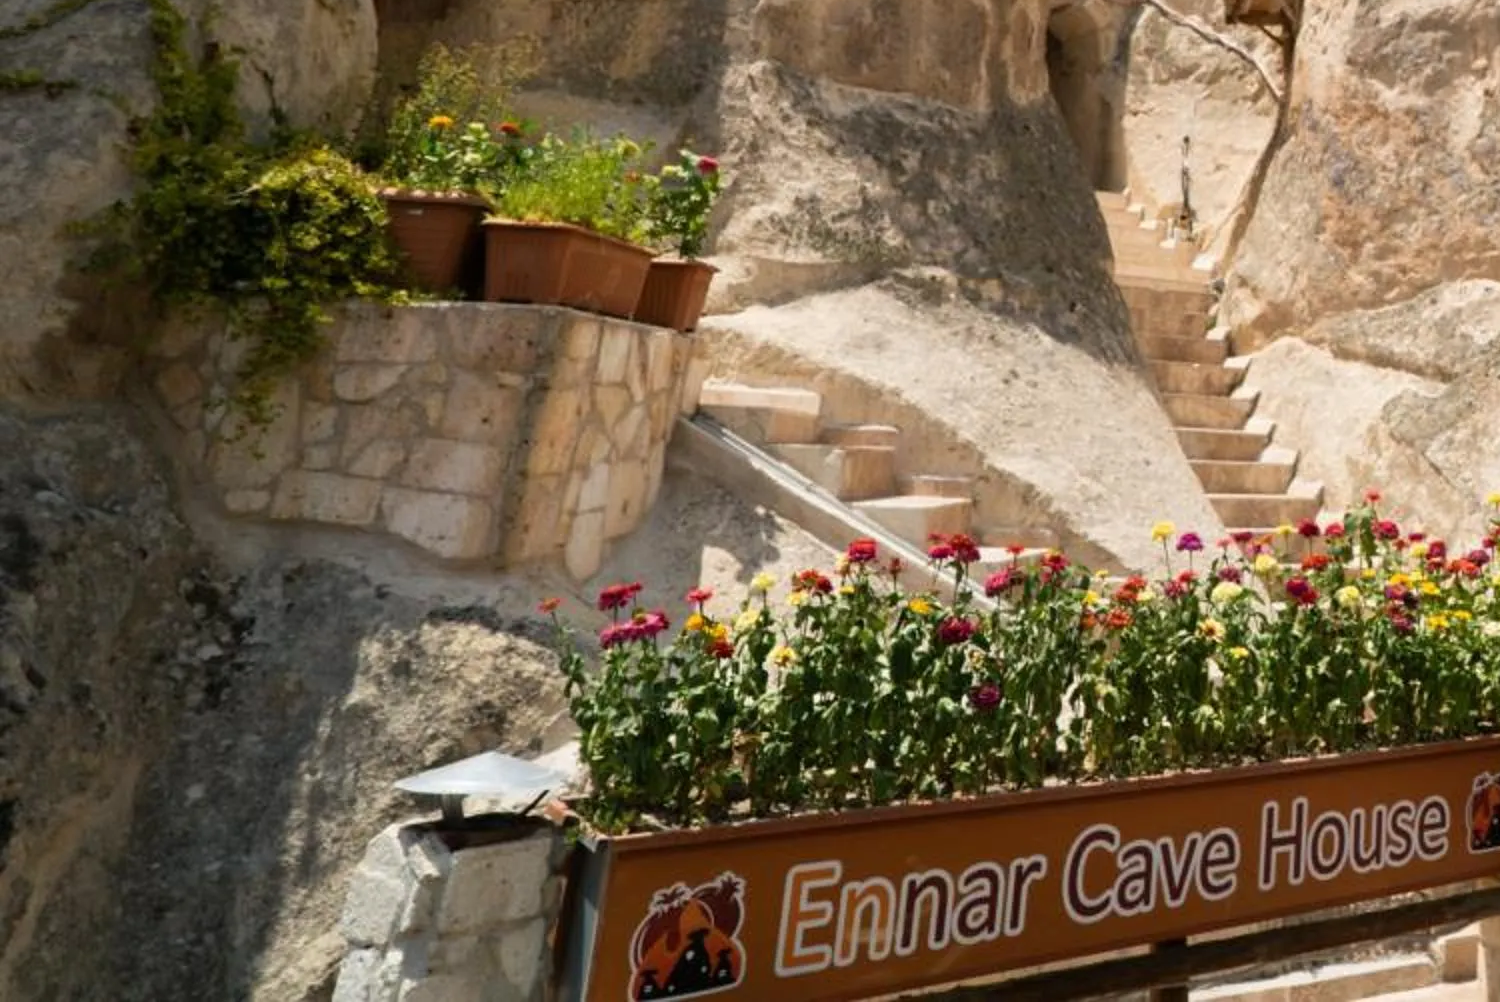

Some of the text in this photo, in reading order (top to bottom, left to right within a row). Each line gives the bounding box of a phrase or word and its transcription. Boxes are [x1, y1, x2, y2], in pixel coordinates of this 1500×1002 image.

[774, 796, 1449, 977] Ennar Cave House
